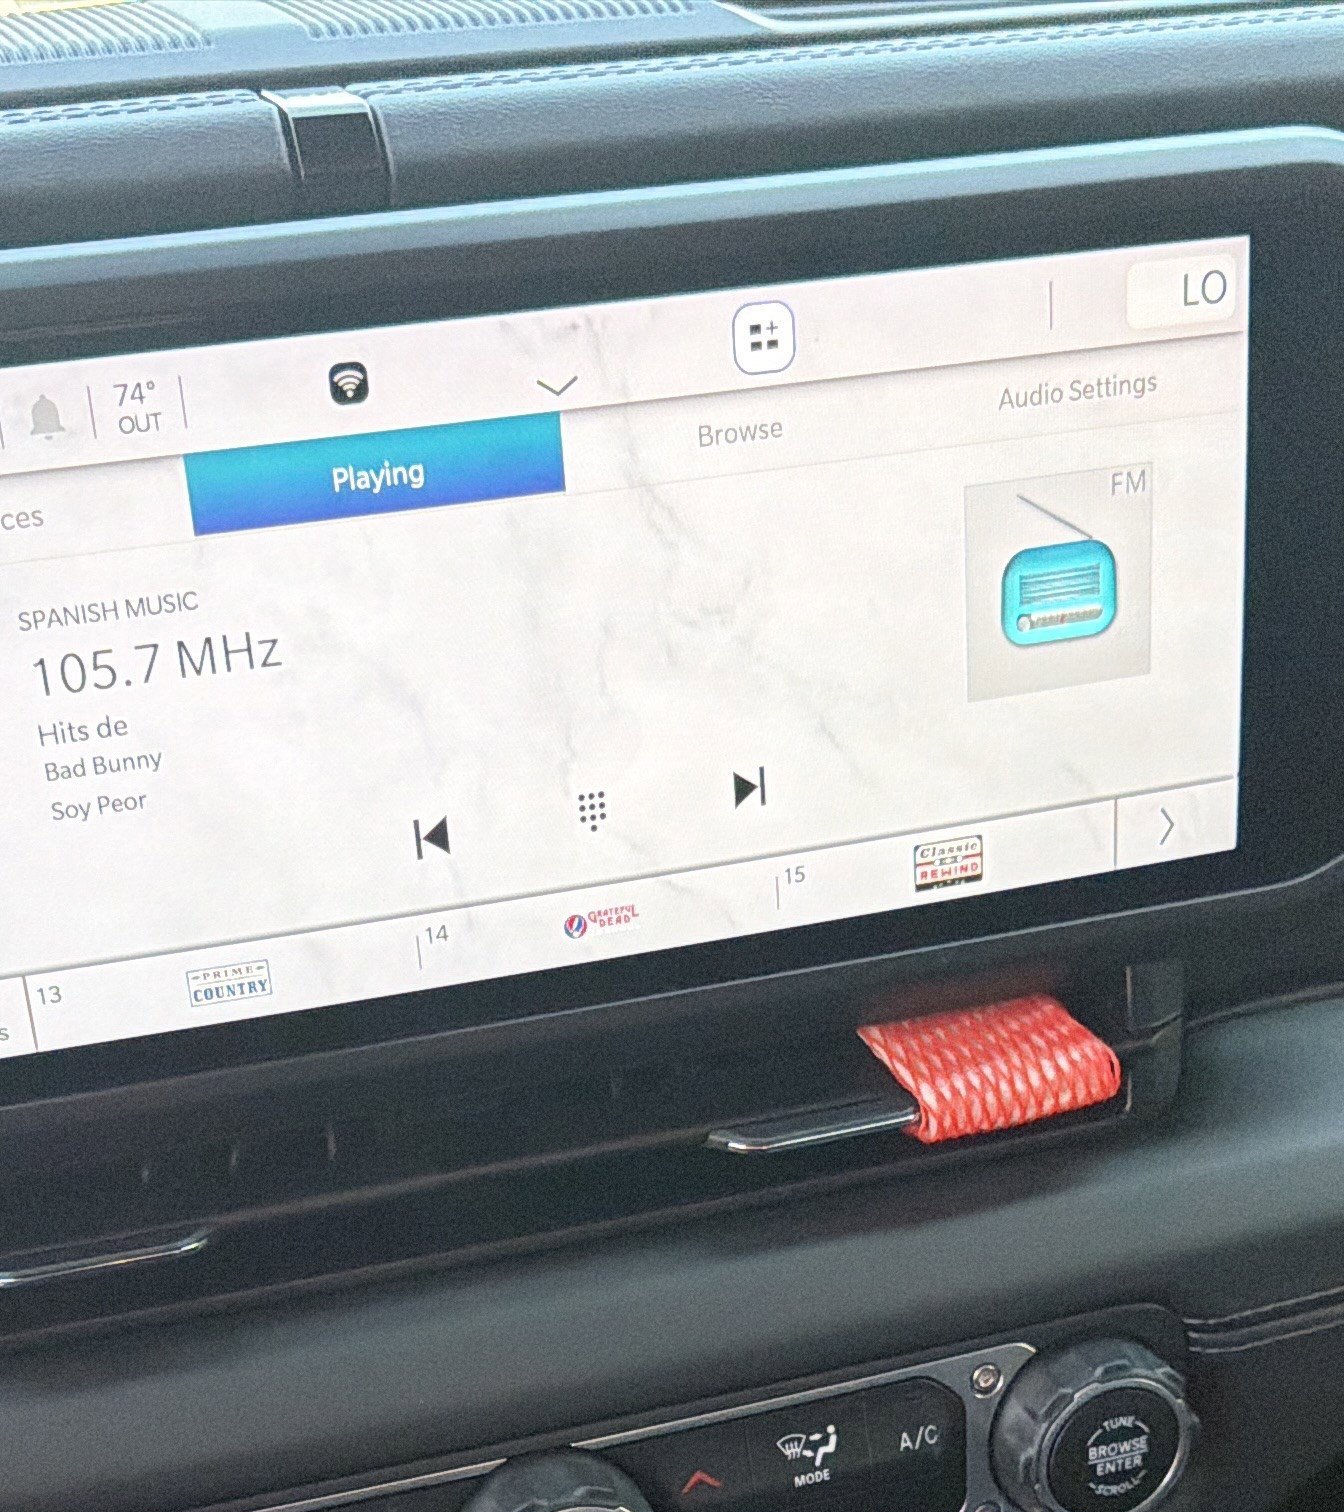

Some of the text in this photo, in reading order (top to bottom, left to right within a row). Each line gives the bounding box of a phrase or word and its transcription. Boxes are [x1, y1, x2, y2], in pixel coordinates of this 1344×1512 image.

[1183, 269, 1227, 306] LO
[113, 380, 156, 406] 74°
[998, 373, 1157, 411] Audio Settings
[118, 412, 162, 435] OUT
[696, 417, 784, 450] Browse
[332, 460, 426, 495] Playing
[1110, 469, 1146, 496] FM
[18, 591, 199, 631] SPANISH MUSIC
[33, 631, 282, 696] 105.7 MHz
[37, 715, 128, 746] Hits de
[44, 752, 162, 781] Bad Bunny
[51, 794, 147, 822] Soy Peor
[920, 842, 978, 858] Classic
[784, 865, 806, 887] 15
[920, 862, 979, 880] REWIND
[599, 915, 631, 928] DEAD
[425, 923, 449, 945] 14
[203, 966, 253, 980] PRIME
[36, 985, 62, 1006] 13
[193, 979, 268, 1002] COUNTRY
[1102, 1415, 1135, 1433] TUNE
[900, 1424, 939, 1452] A/C
[1088, 1435, 1149, 1460] BROWSE
[1096, 1455, 1143, 1476] ENTER
[794, 1469, 831, 1488] MODE
[1094, 1476, 1140, 1496] SCROLL
